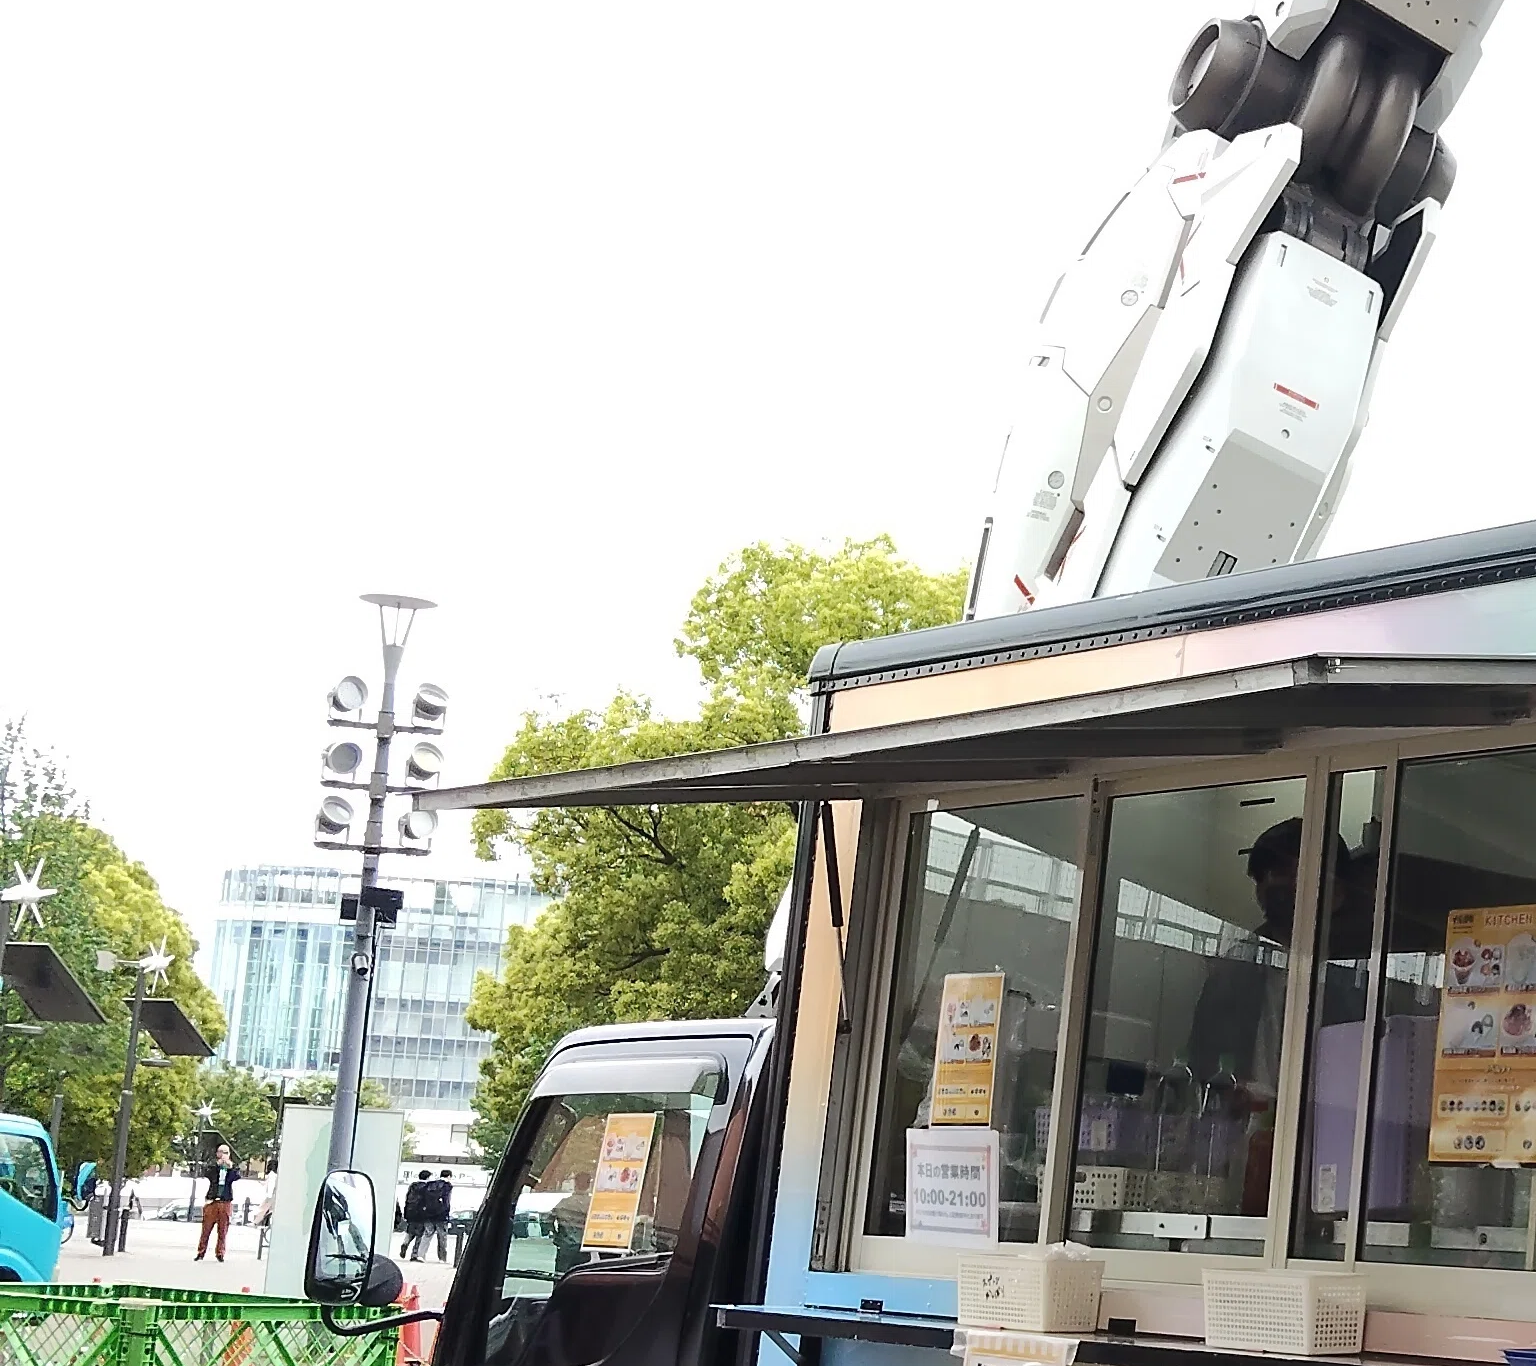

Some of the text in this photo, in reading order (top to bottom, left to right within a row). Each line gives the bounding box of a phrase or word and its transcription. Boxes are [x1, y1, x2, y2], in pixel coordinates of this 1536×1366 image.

[1484, 913, 1533, 927] KITCHEN
[916, 1162, 981, 1181] 本日の営業時間
[913, 1187, 987, 1208] 10:00-21:00
